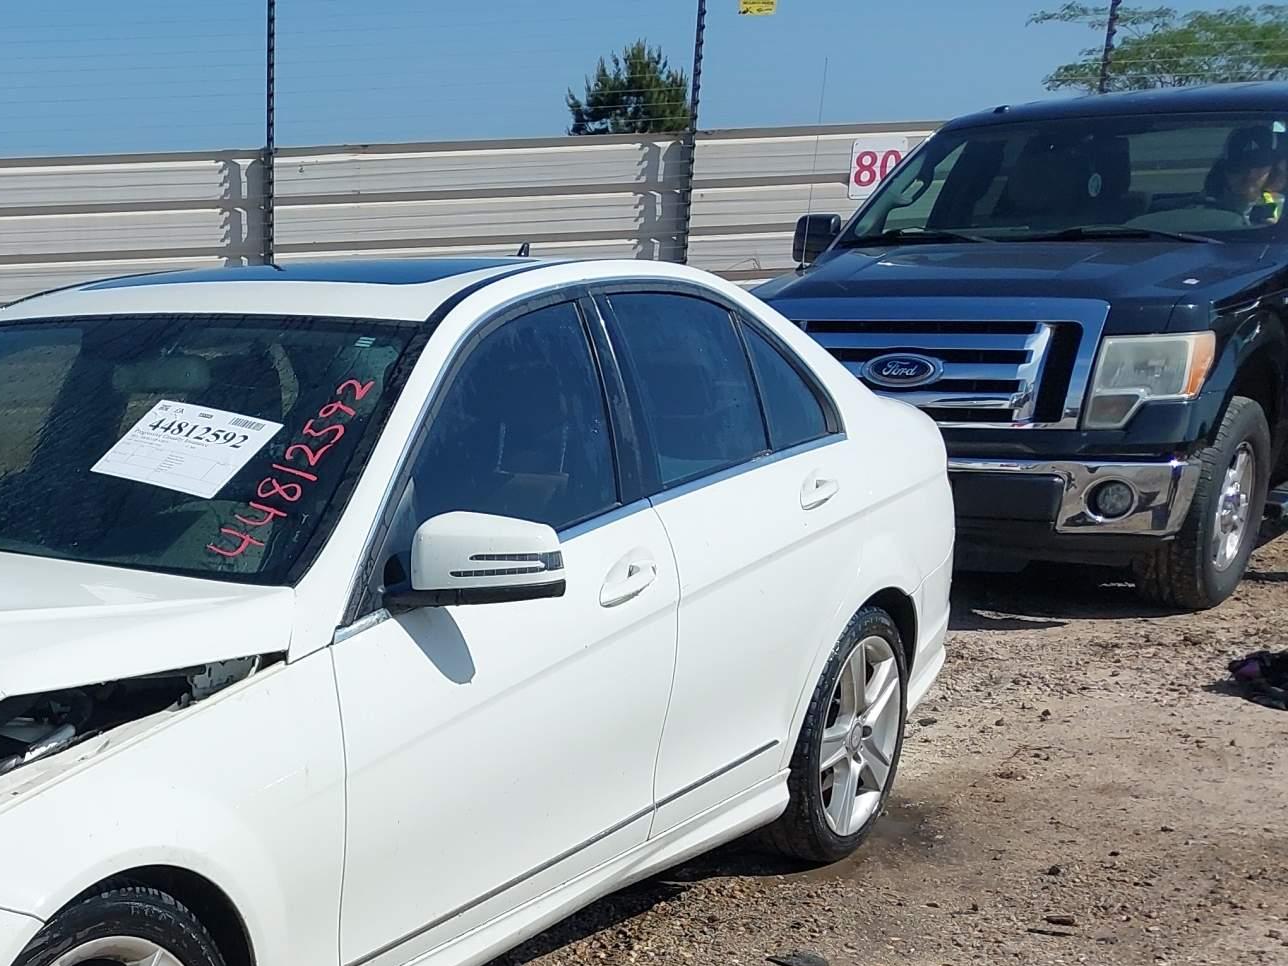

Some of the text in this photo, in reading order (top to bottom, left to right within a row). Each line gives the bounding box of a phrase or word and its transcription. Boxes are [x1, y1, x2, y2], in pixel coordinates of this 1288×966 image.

[882, 360, 918, 376] Ford
[149, 417, 249, 449] 44812592
[207, 379, 375, 557] 44812592
